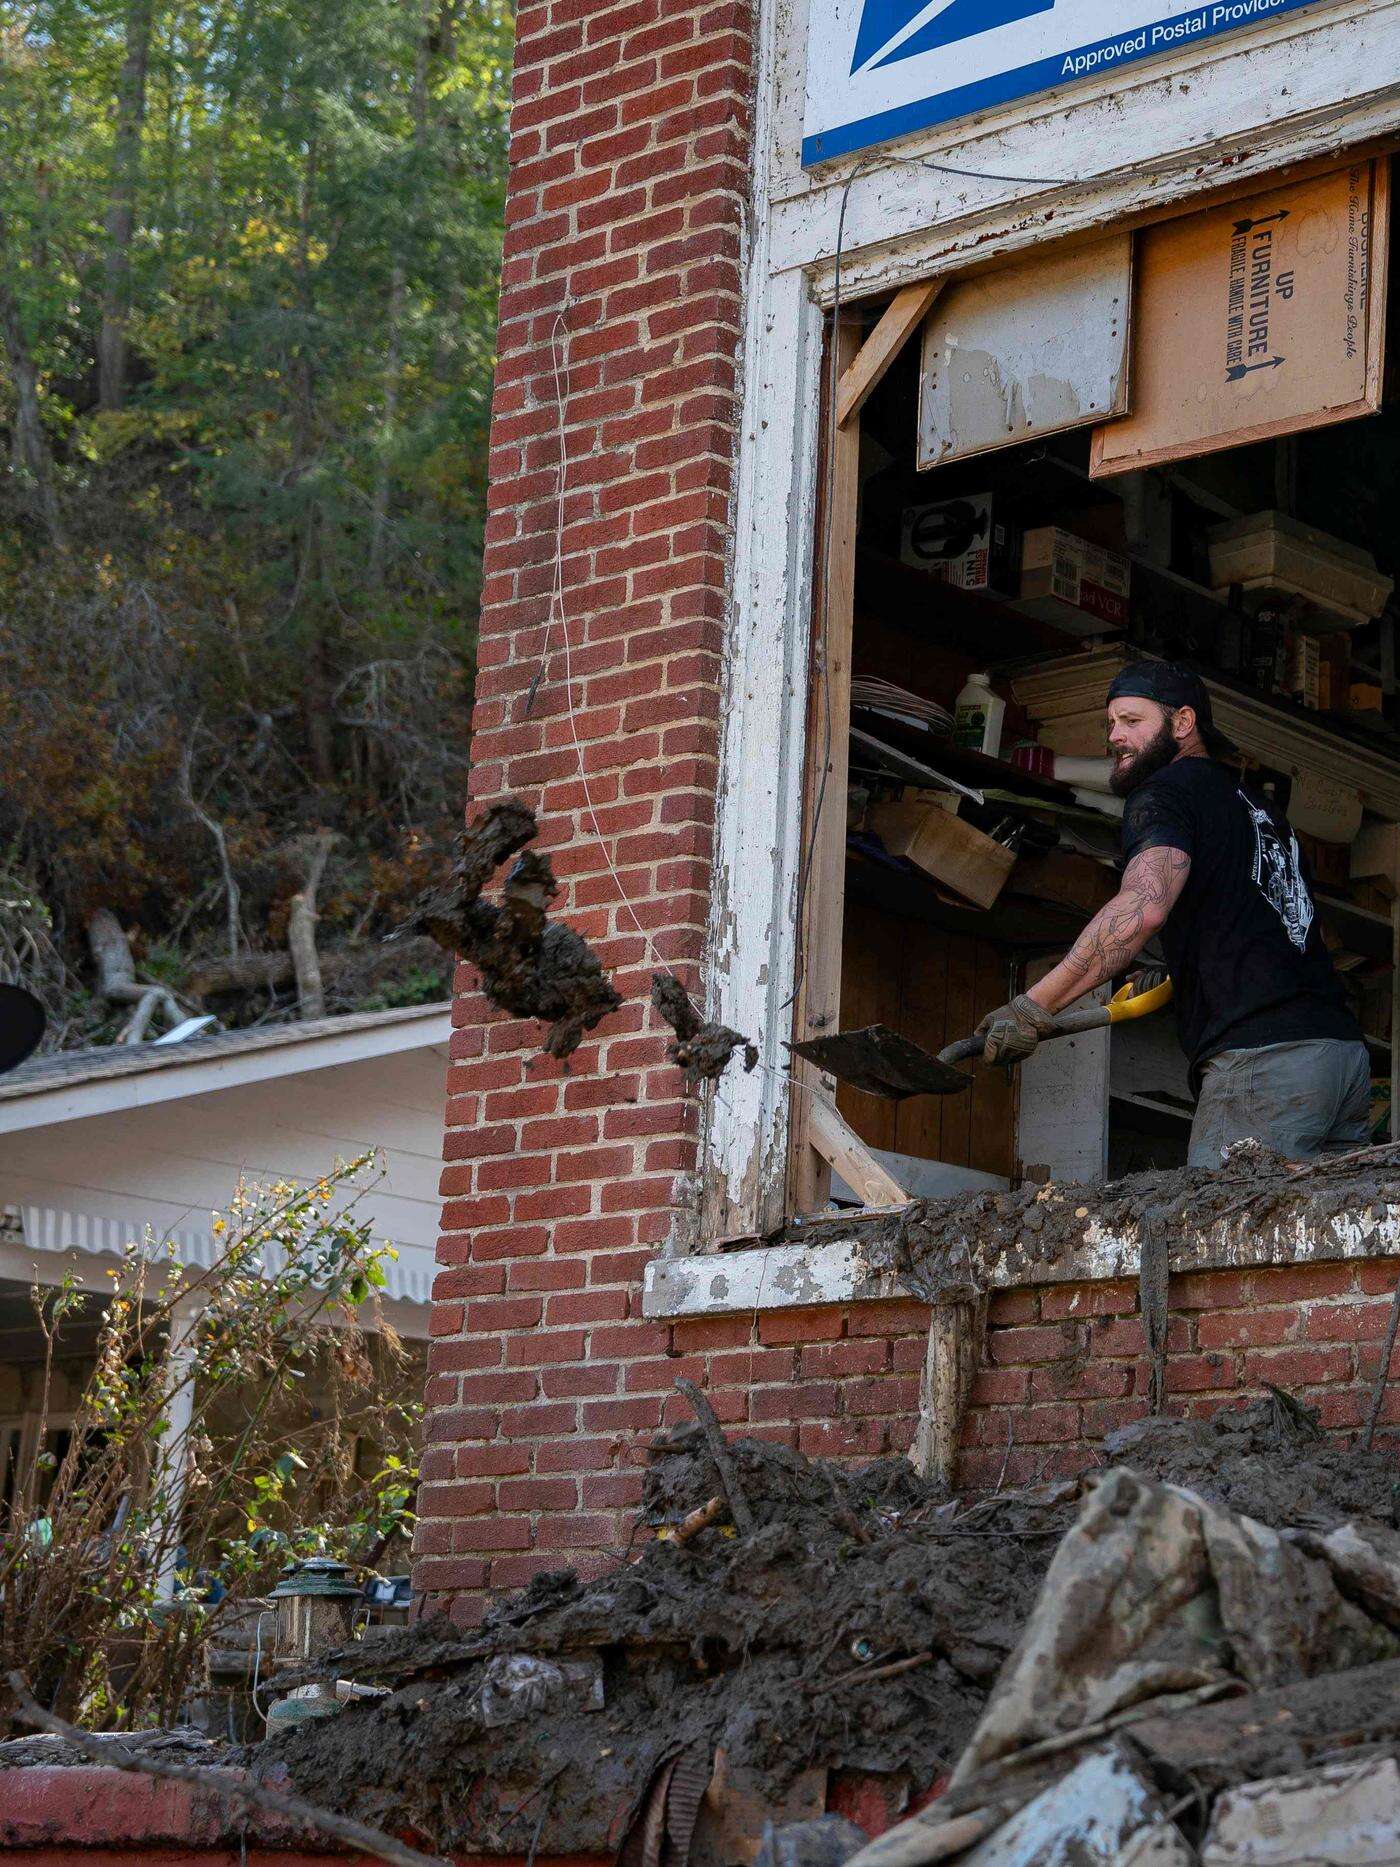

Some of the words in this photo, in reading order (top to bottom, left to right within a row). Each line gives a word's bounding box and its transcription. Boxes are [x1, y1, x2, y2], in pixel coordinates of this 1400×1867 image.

[1062, 30, 1146, 75] Approved
[1150, 15, 1207, 46] Postal
[1349, 167, 1361, 192] The
[1348, 194, 1360, 234] Home
[1229, 235, 1247, 279] FRAGILE,
[1343, 233, 1360, 315] Furnishings
[1228, 276, 1245, 315] HANDLE
[1248, 229, 1273, 358] FURNITURE
[1275, 270, 1295, 301] UP
[1227, 312, 1245, 338] WITH
[1342, 314, 1359, 360] People
[1226, 336, 1243, 366] CARE
[1097, 595, 1121, 618] VCR
